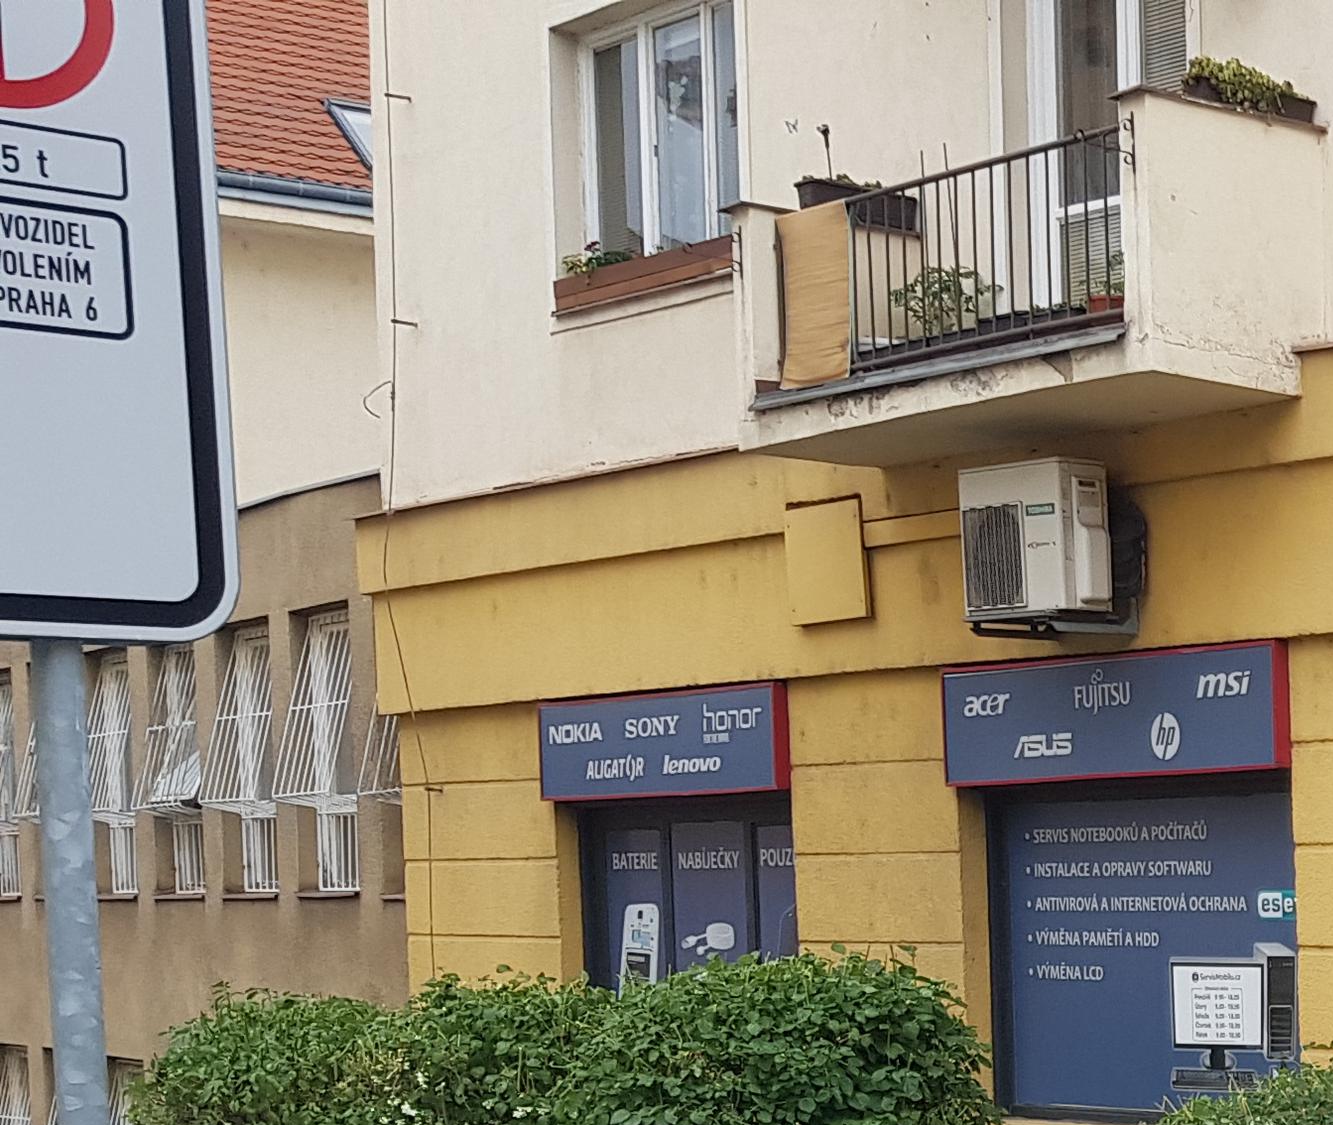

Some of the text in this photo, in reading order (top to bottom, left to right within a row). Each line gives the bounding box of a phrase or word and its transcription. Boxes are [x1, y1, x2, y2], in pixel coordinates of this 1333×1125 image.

[36, 149, 50, 179] t
[0, 211, 96, 250] VOZIDEL
[0, 250, 92, 286] OLENÍM
[85, 296, 99, 322] 6
[1073, 679, 1133, 716] FUJITSU
[1196, 670, 1252, 700] msi
[963, 691, 1011, 718] acer
[624, 715, 680, 740] SONY
[702, 703, 763, 732] honor
[549, 721, 604, 746] NOKIA
[1013, 732, 1074, 760] ASUS
[662, 754, 722, 776] lenovo
[1032, 819, 1208, 844] SERVIS NOTEBOOKŮ A POČÍTAČŮ
[612, 852, 659, 871] BATERIE
[677, 846, 740, 870] NABÍJEČKY
[1033, 860, 1212, 878] INSTALACE A OPRAVY SOFTWARU
[1035, 893, 1248, 912] ANTIVIROVÁ A INTERNETOVÁ OCHRANA
[1036, 928, 1160, 947] VÝMĚNA PAMĚTÍ A HDD
[1036, 963, 1104, 981] VÝMĚNA LCD
